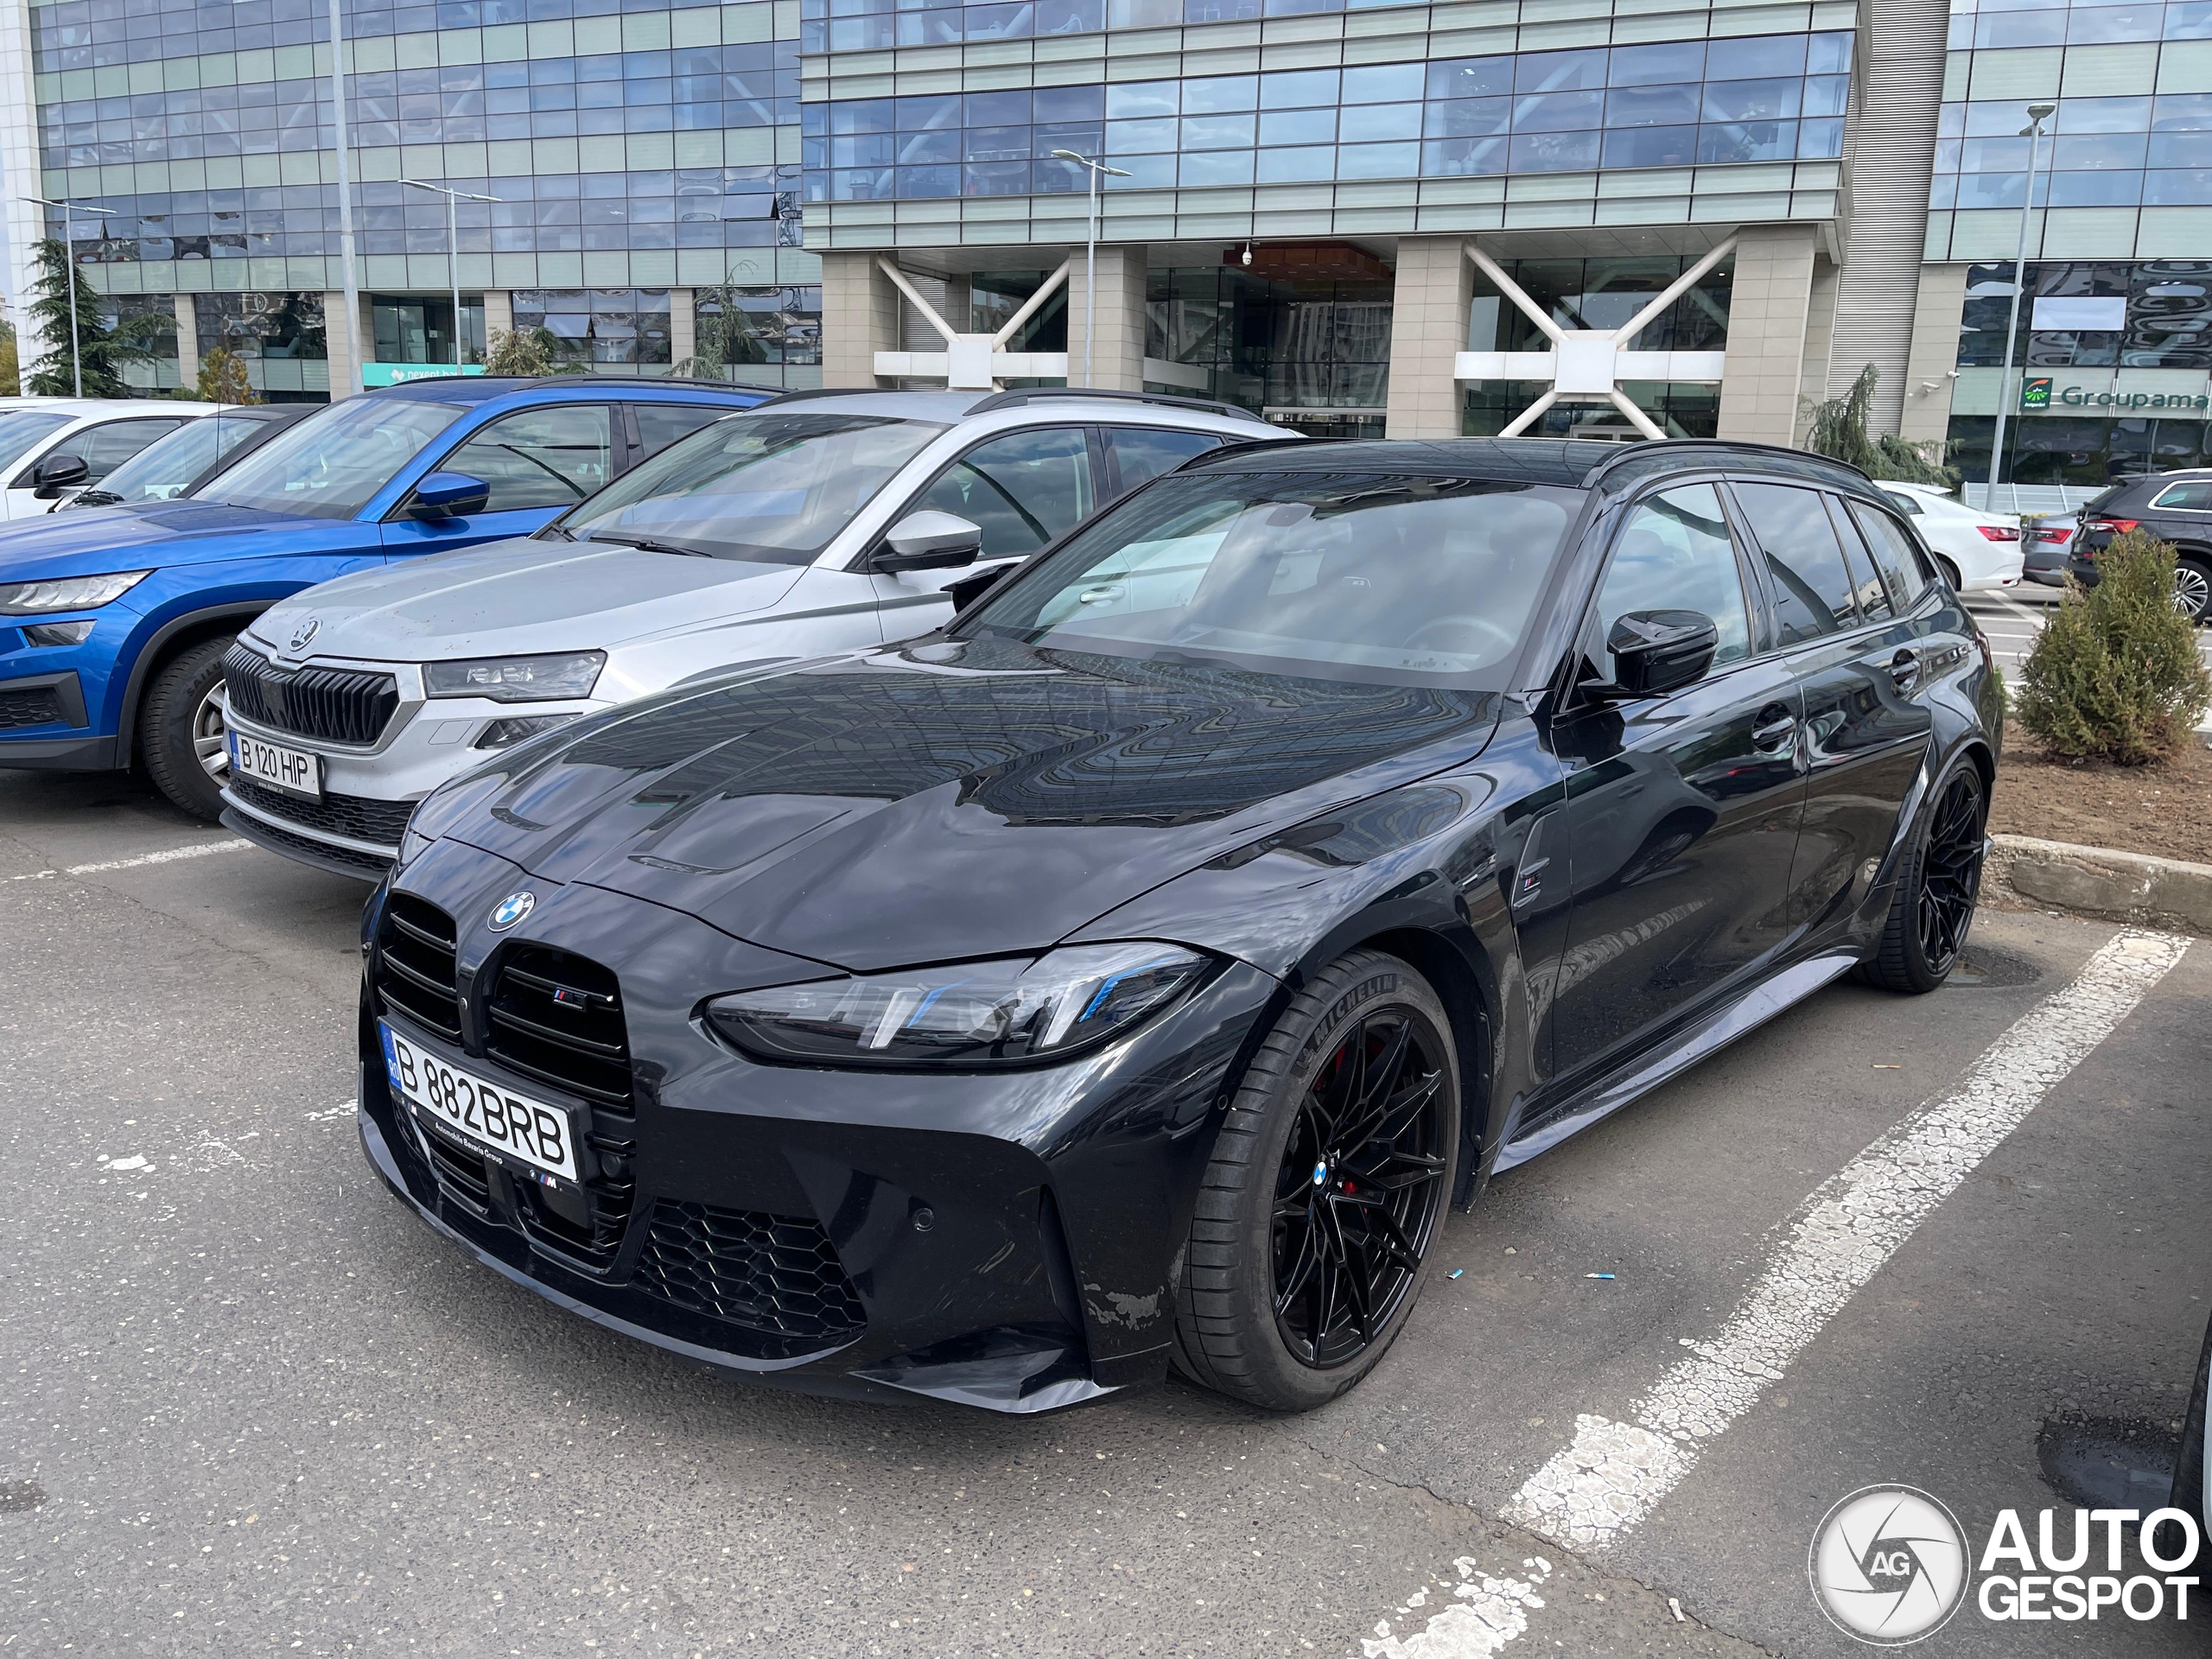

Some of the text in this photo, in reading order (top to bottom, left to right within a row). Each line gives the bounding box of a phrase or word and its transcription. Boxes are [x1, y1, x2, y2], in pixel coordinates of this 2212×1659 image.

[408, 370, 440, 379] nexent
[2061, 386, 2209, 410] Groupama
[186, 660, 222, 697] SAILU
[240, 738, 308, 786] B 120 HIP
[507, 892, 533, 908] BMW
[1313, 975, 1395, 1047] MICHELIN
[388, 1058, 400, 1082] RO
[395, 1039, 418, 1093] B
[435, 1122, 504, 1165] Automobile Bavaria Group
